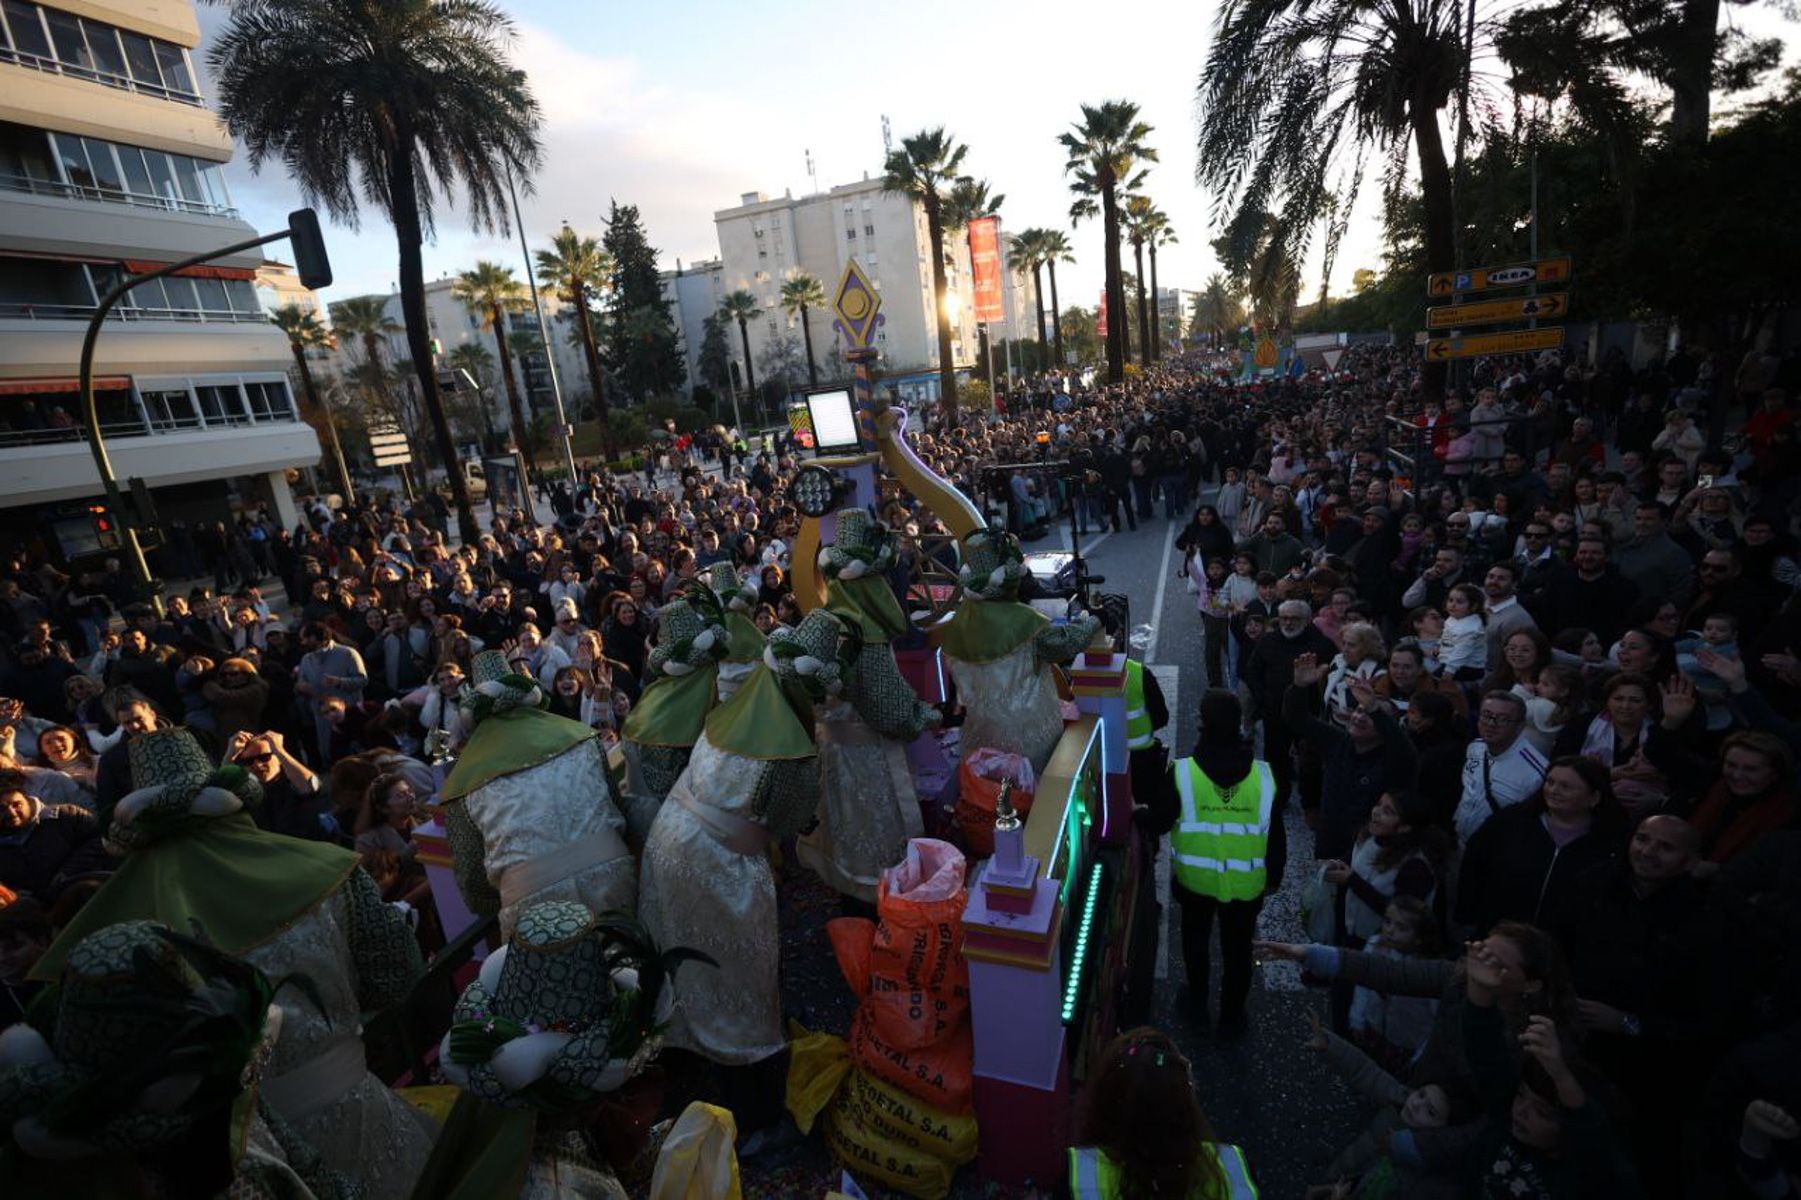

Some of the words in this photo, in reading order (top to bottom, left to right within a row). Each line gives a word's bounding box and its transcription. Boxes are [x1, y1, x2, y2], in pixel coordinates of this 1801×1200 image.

[1492, 270, 1529, 281] IKEA
[915, 1064, 947, 1092] S.A.
[919, 1116, 953, 1143] S.A.
[886, 1157, 919, 1179] S.A.
